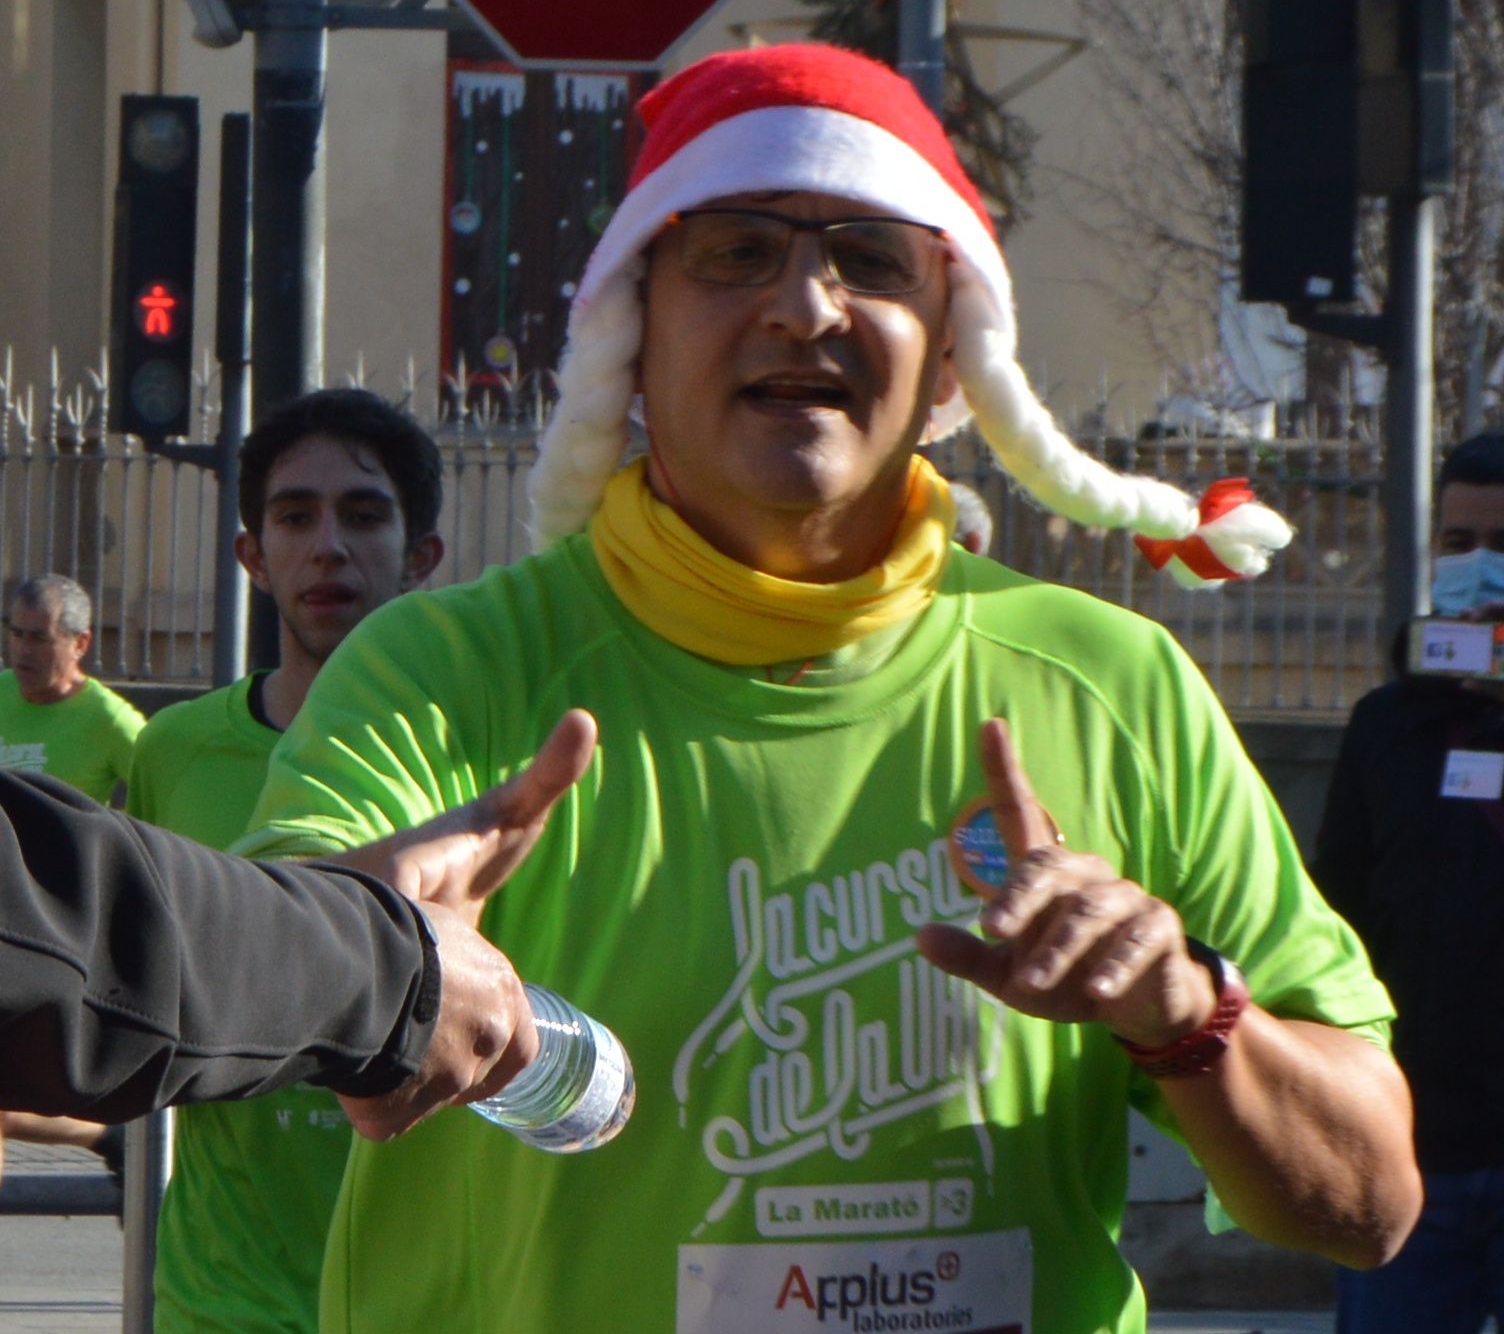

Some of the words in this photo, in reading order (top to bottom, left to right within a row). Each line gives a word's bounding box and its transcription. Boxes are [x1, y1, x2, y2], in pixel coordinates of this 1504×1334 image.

[767, 1199, 802, 1224] La
[813, 1193, 921, 1222] Marató
[852, 1304, 973, 1334] laboratories
